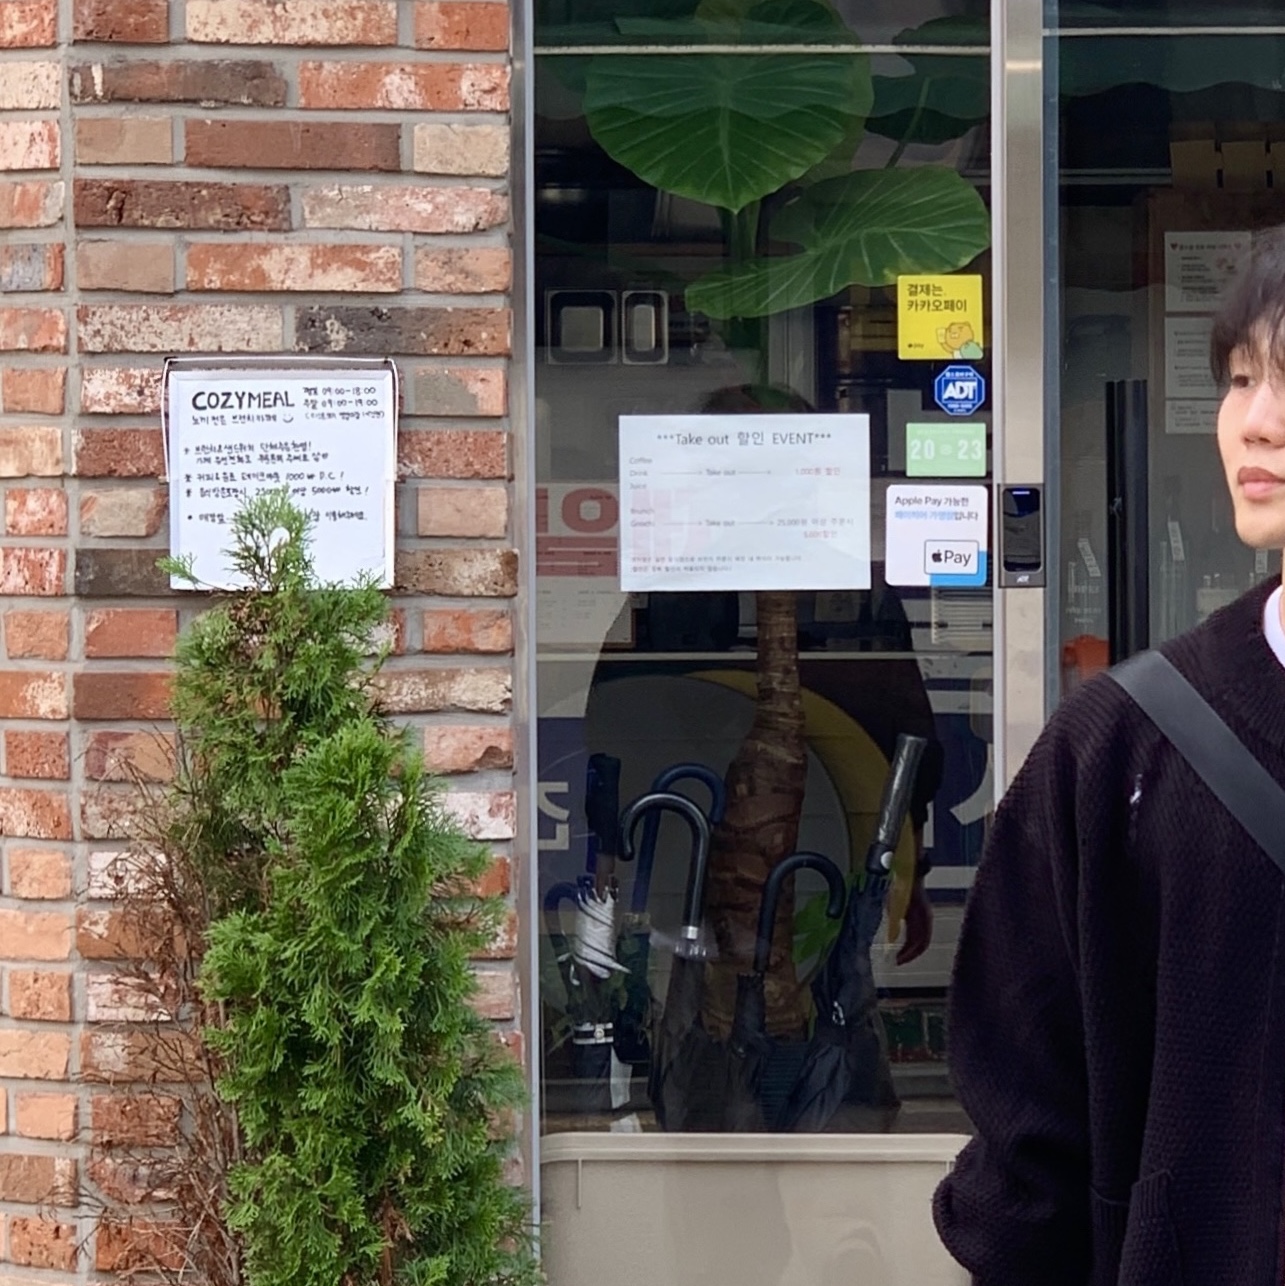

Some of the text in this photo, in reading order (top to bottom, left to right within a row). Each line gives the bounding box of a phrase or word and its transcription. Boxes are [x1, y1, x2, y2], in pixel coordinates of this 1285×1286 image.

[907, 299, 967, 312] 카카오페이
[943, 380, 977, 399] ADT
[191, 390, 295, 411] COZYMEAL
[707, 434, 729, 445] out
[737, 431, 764, 446] 할인
[910, 439, 983, 460] 20 23
[629, 457, 653, 465] Coffee
[629, 469, 648, 477] Drink
[895, 496, 969, 507] Apple Pay 가능한
[944, 549, 972, 567] Pay
